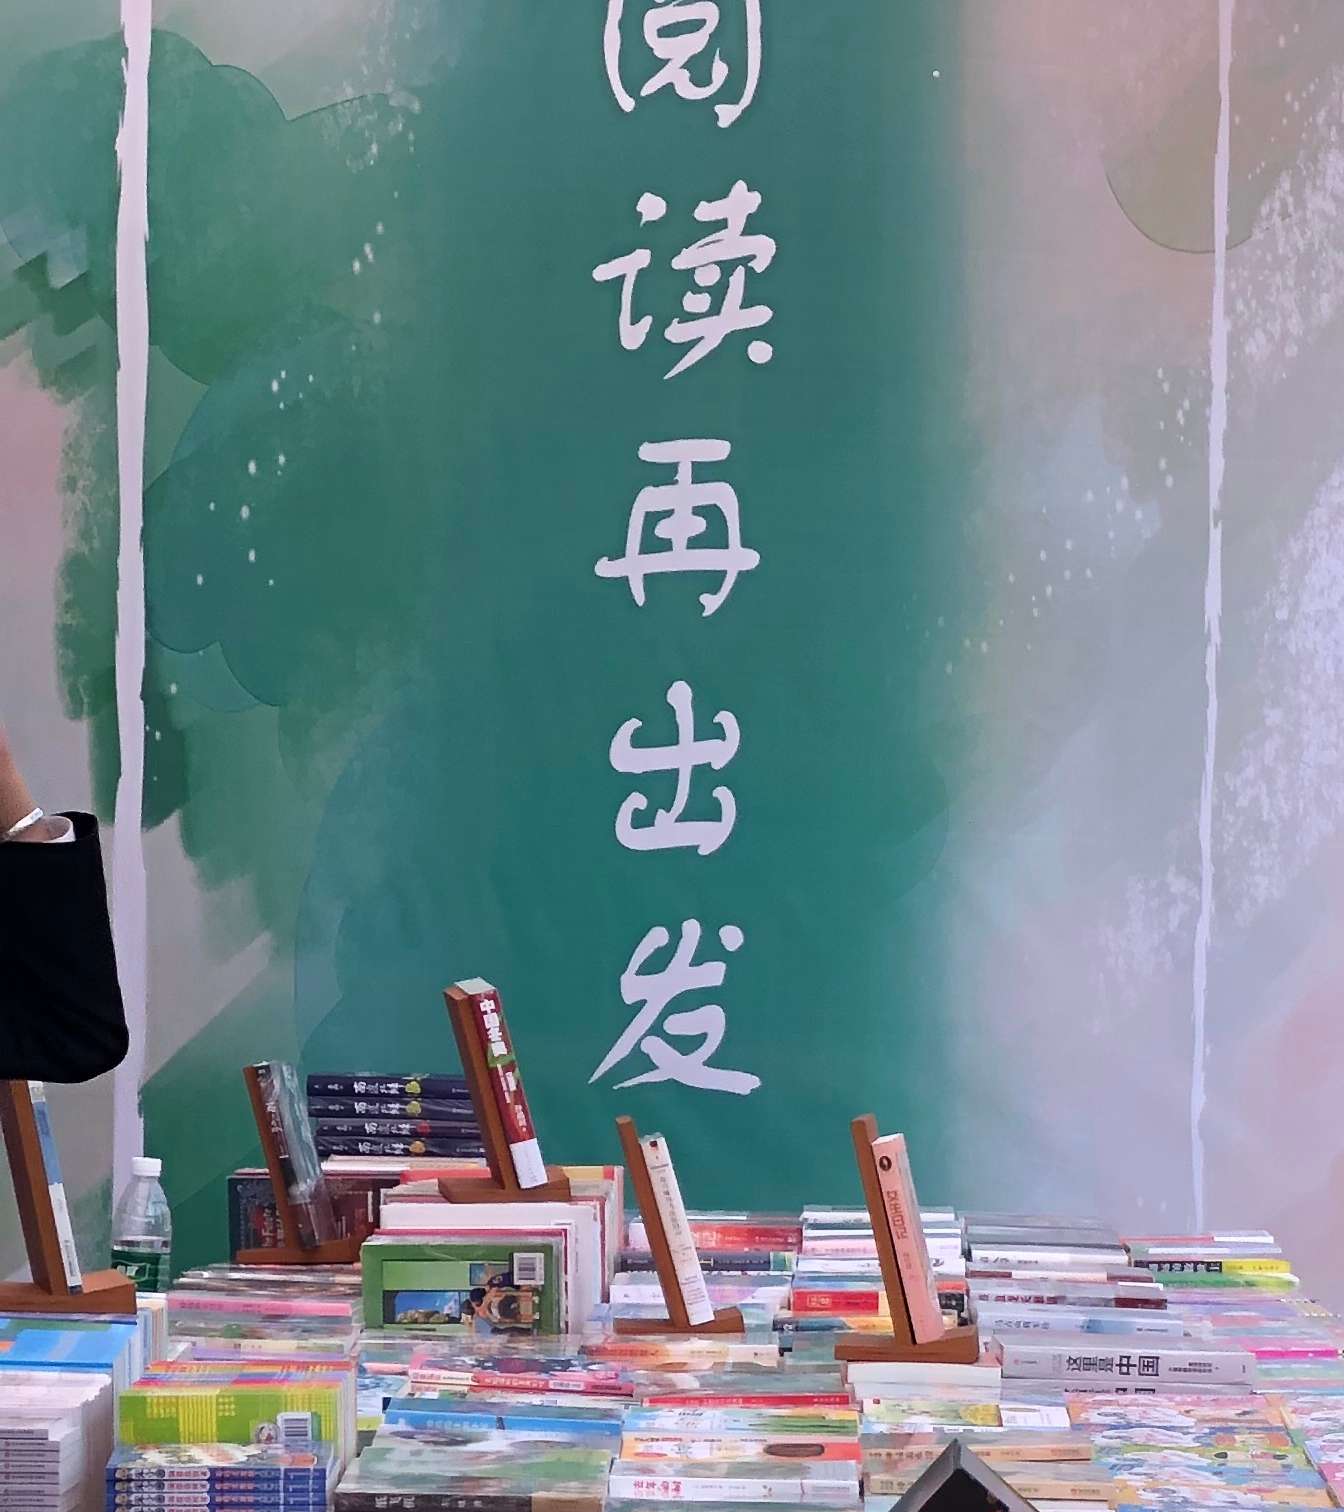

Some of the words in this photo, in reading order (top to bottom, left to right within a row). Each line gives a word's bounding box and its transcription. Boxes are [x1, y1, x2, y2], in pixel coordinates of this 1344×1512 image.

[589, 0, 777, 1097] 阅读再出发
[1065, 1353, 1160, 1378] 这里是中国
